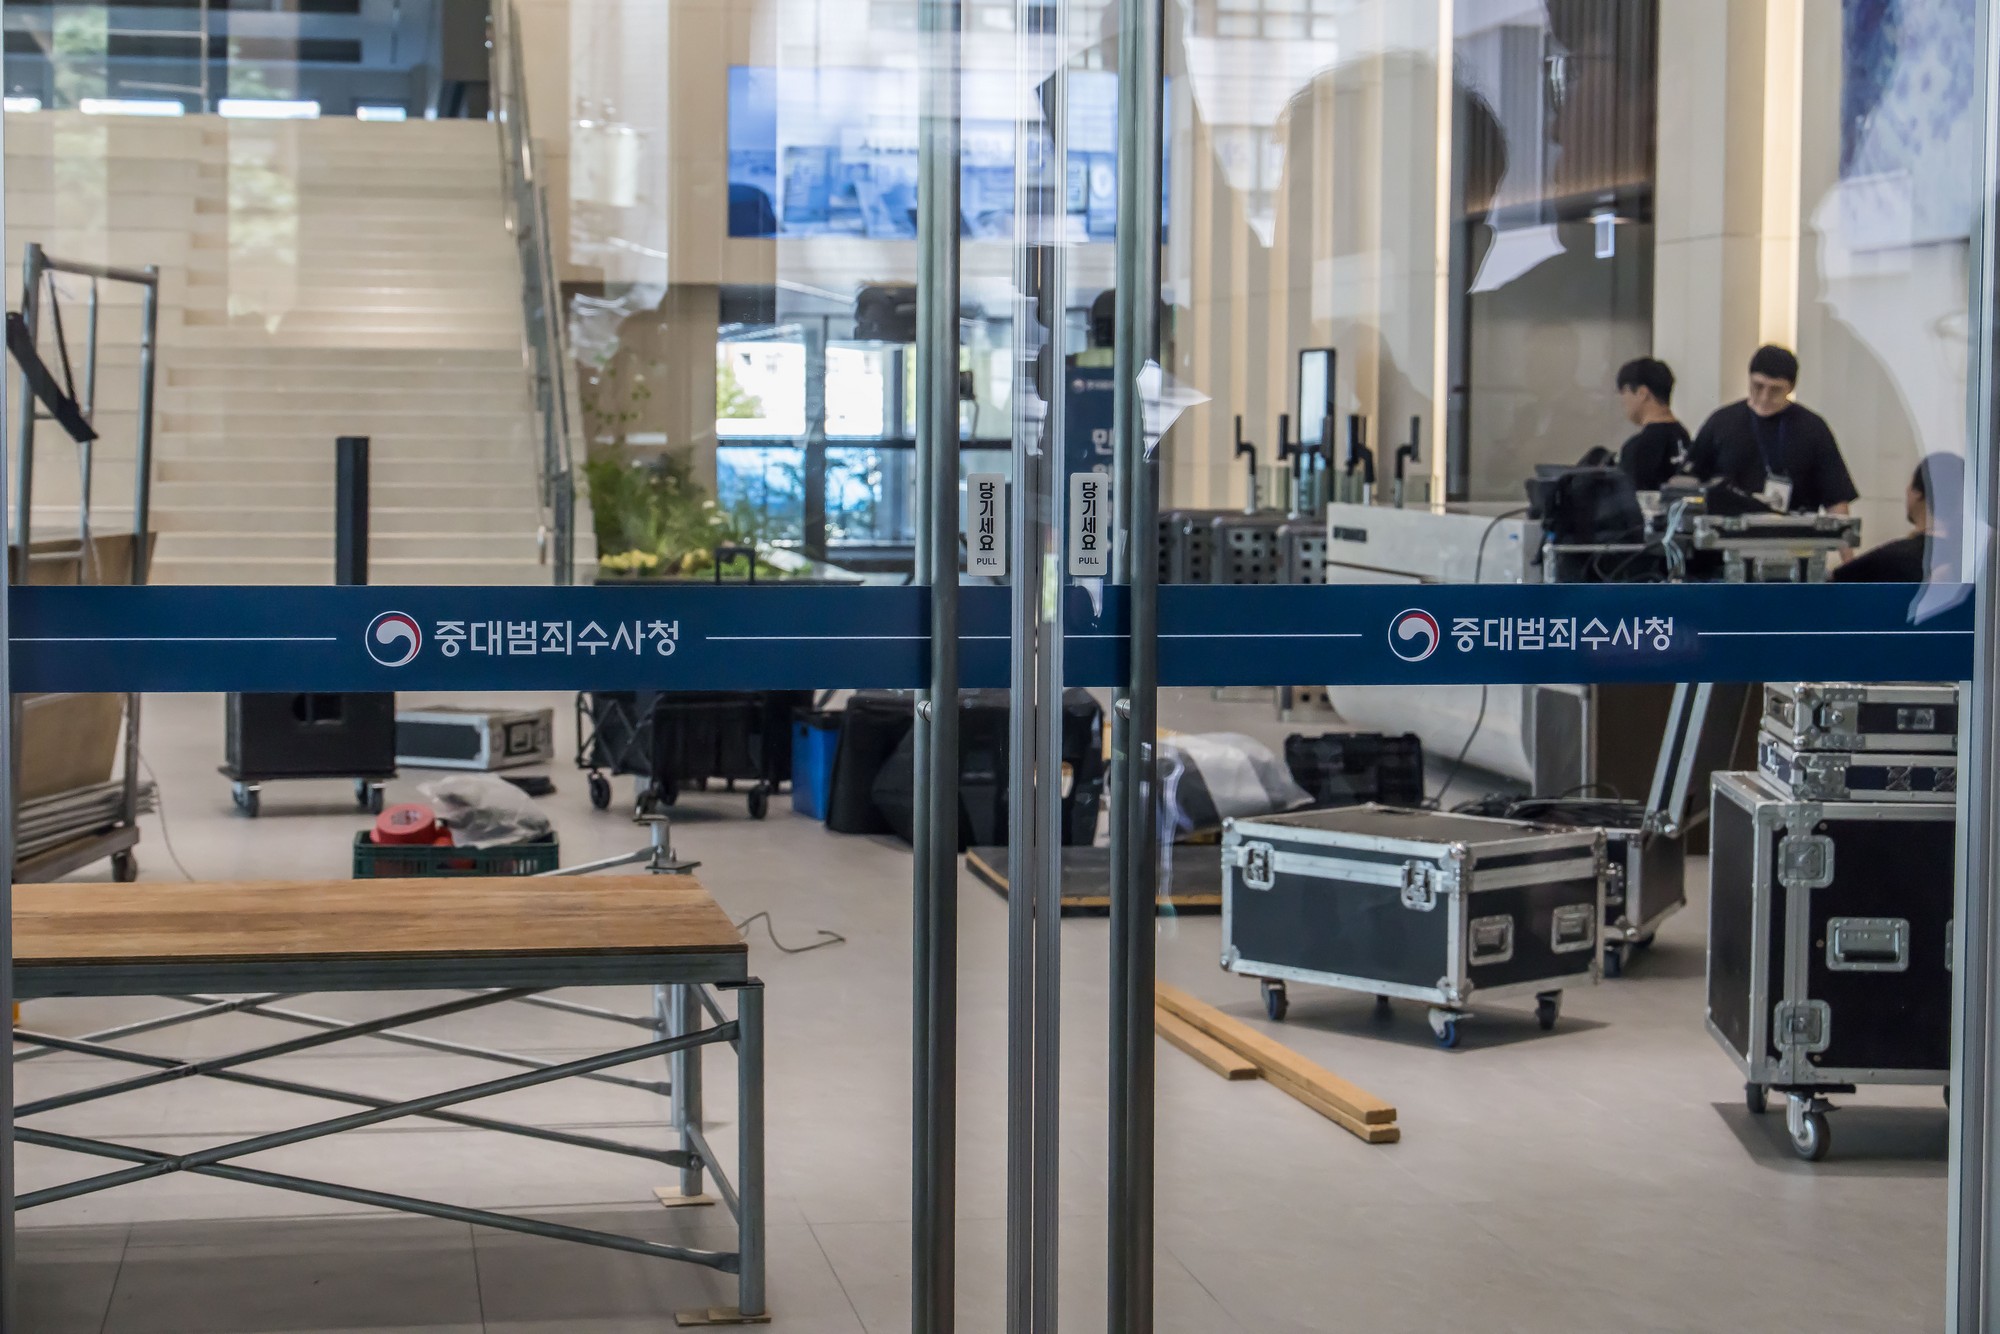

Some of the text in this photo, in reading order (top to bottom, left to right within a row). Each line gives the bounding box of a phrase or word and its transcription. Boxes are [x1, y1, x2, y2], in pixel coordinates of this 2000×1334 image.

[979, 482, 995, 551] 당기세요
[1081, 482, 1098, 550] 당기세요
[1078, 557, 1099, 565] PULL
[434, 620, 679, 657] 중대범죄수사청
[1451, 617, 1673, 652] 중대범죄수사청
